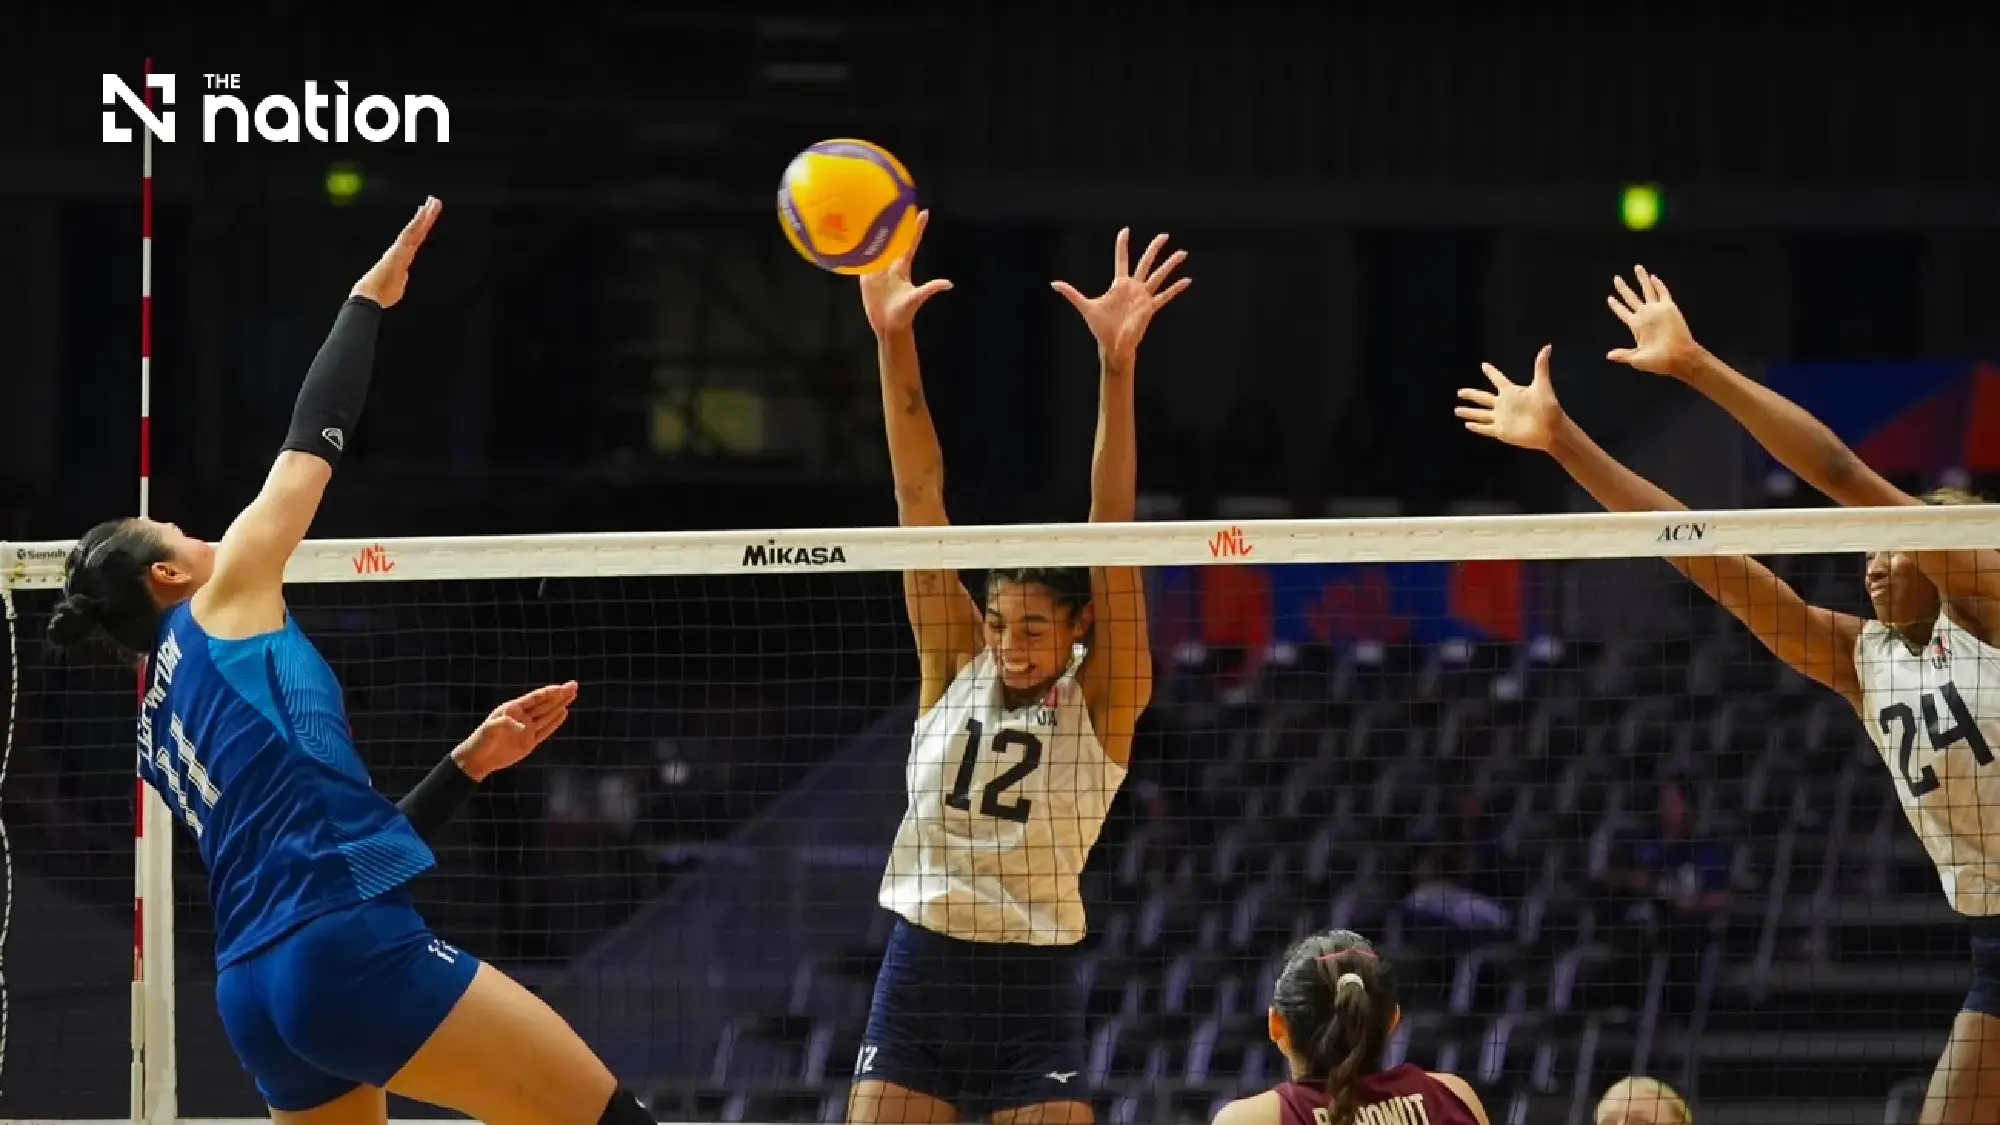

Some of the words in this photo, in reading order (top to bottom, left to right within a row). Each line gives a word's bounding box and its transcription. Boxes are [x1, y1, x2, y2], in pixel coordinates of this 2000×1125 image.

[1657, 523, 1706, 541] ACN
[157, 713, 222, 837] 11
[945, 717, 1043, 823] 12
[1880, 681, 1995, 797] 24
[854, 1046, 878, 1076] 12
